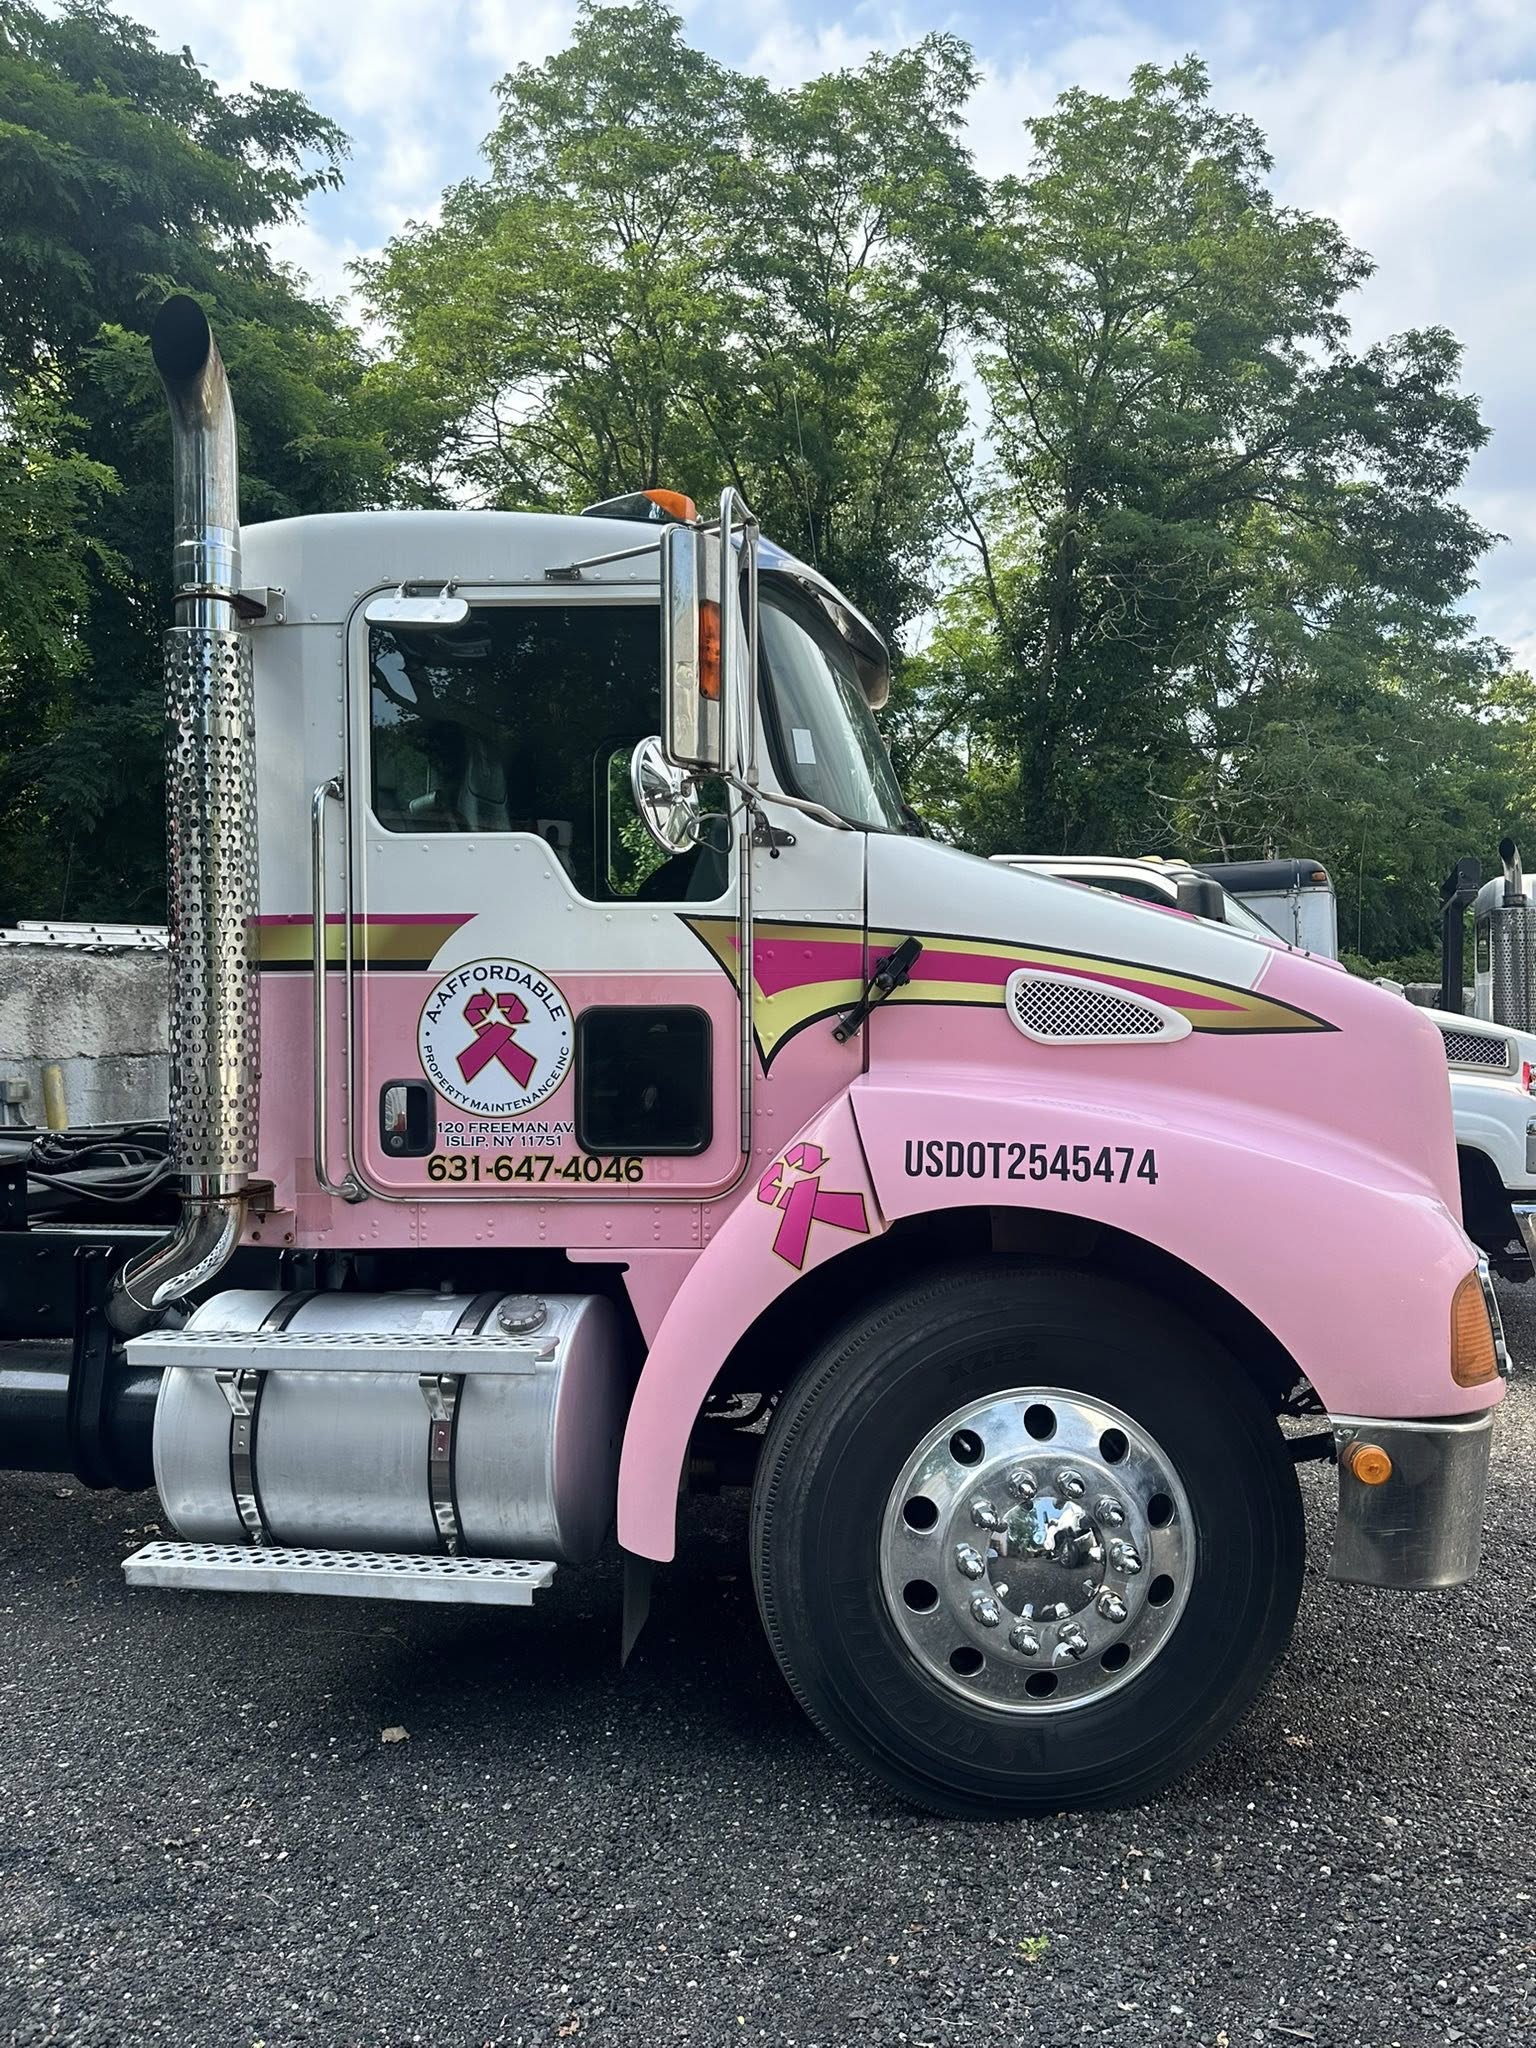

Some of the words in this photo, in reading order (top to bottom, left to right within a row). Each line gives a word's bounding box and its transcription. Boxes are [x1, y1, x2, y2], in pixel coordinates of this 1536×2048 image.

[426, 965, 566, 1024] A-AFFORDABLE
[424, 1045, 470, 1105] PROPERTY
[470, 1070, 561, 1113] MAINTENANCE
[556, 1046, 570, 1073] INC
[437, 1122, 465, 1134] 120
[469, 1122, 551, 1134] FREEMAN
[552, 1122, 575, 1134] AV.
[446, 1136, 488, 1148] ISLIP,
[493, 1136, 515, 1147] NY
[521, 1135, 562, 1147] 11751
[428, 1154, 644, 1183] 631-647-4046
[904, 1140, 1159, 1185] USDOT2545474
